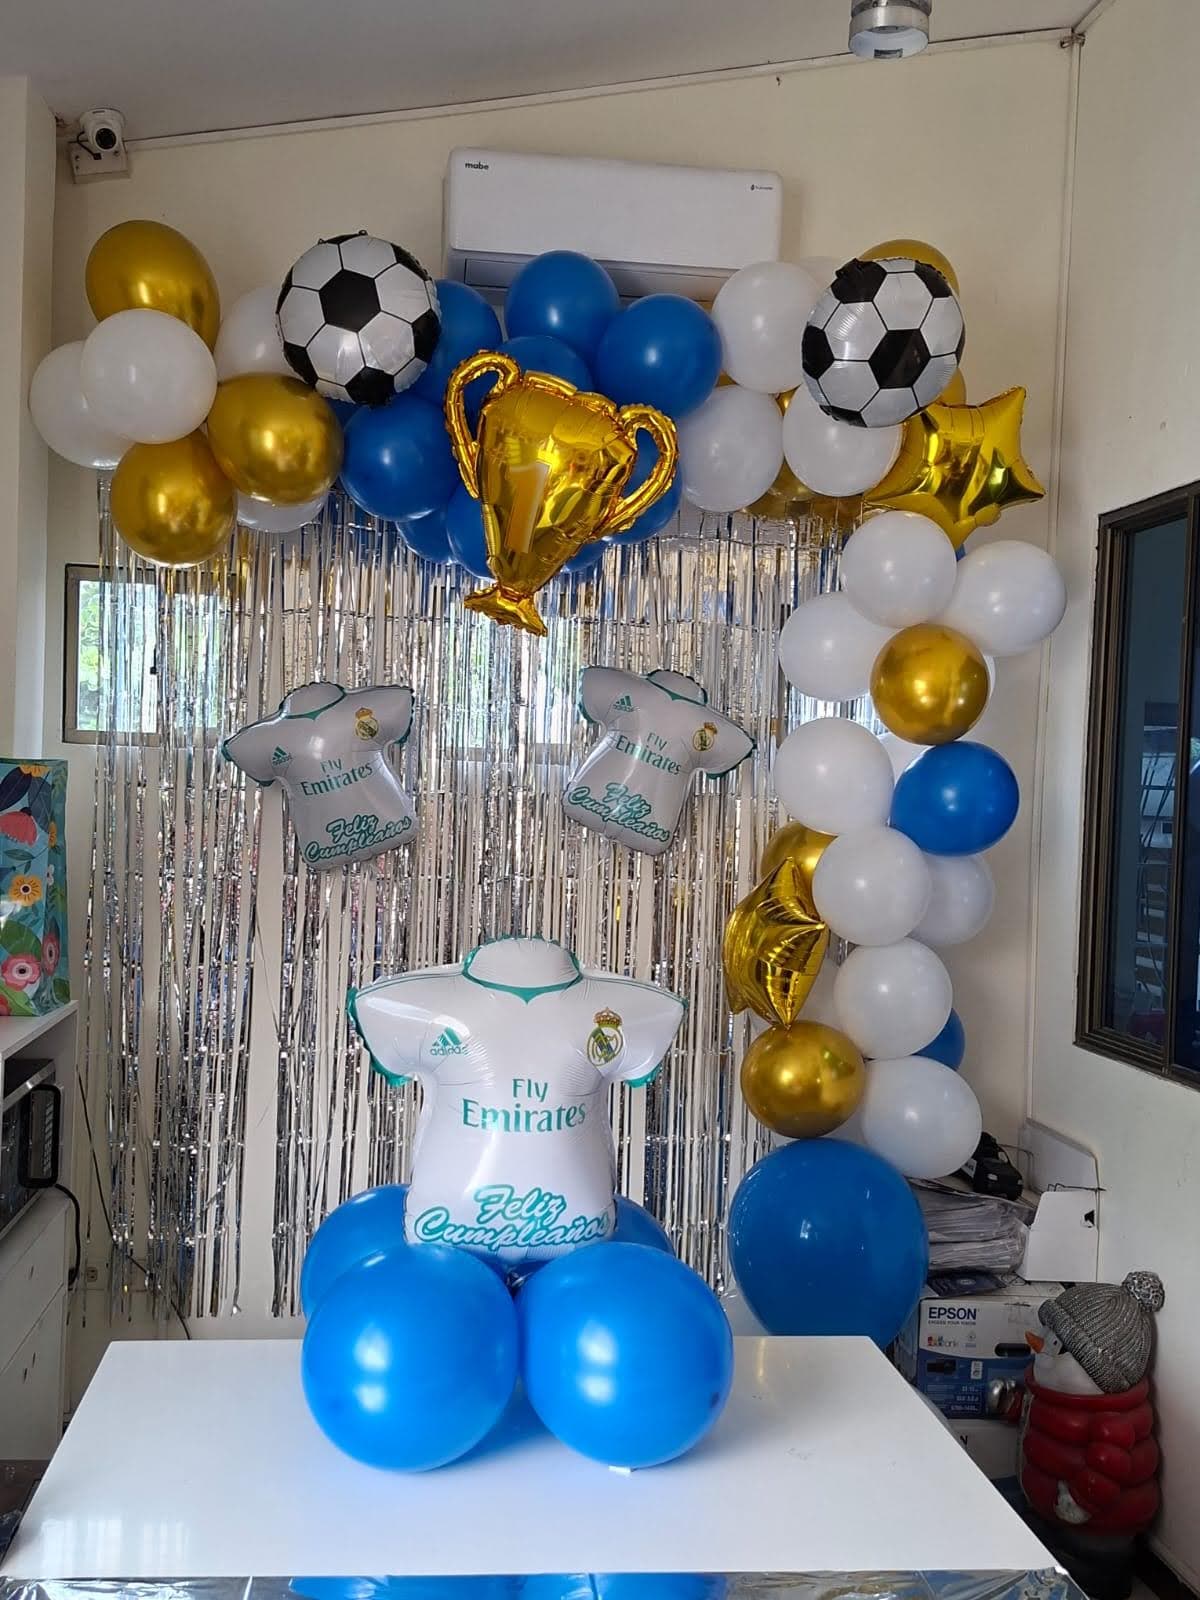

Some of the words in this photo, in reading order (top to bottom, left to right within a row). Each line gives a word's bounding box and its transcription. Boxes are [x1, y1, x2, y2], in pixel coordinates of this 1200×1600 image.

[464, 161, 489, 170] mabe
[615, 735, 681, 775] Emirates
[646, 732, 668, 751] Fly
[301, 762, 373, 796] Emirates
[320, 758, 343, 773] Fly
[326, 814, 379, 843] Feliz
[512, 1078, 548, 1102] Fly
[462, 1098, 587, 1133] Emirates
[474, 1184, 568, 1225] Feliz
[414, 1206, 610, 1251] Cumpleaños
[929, 1307, 977, 1320] EPSON
